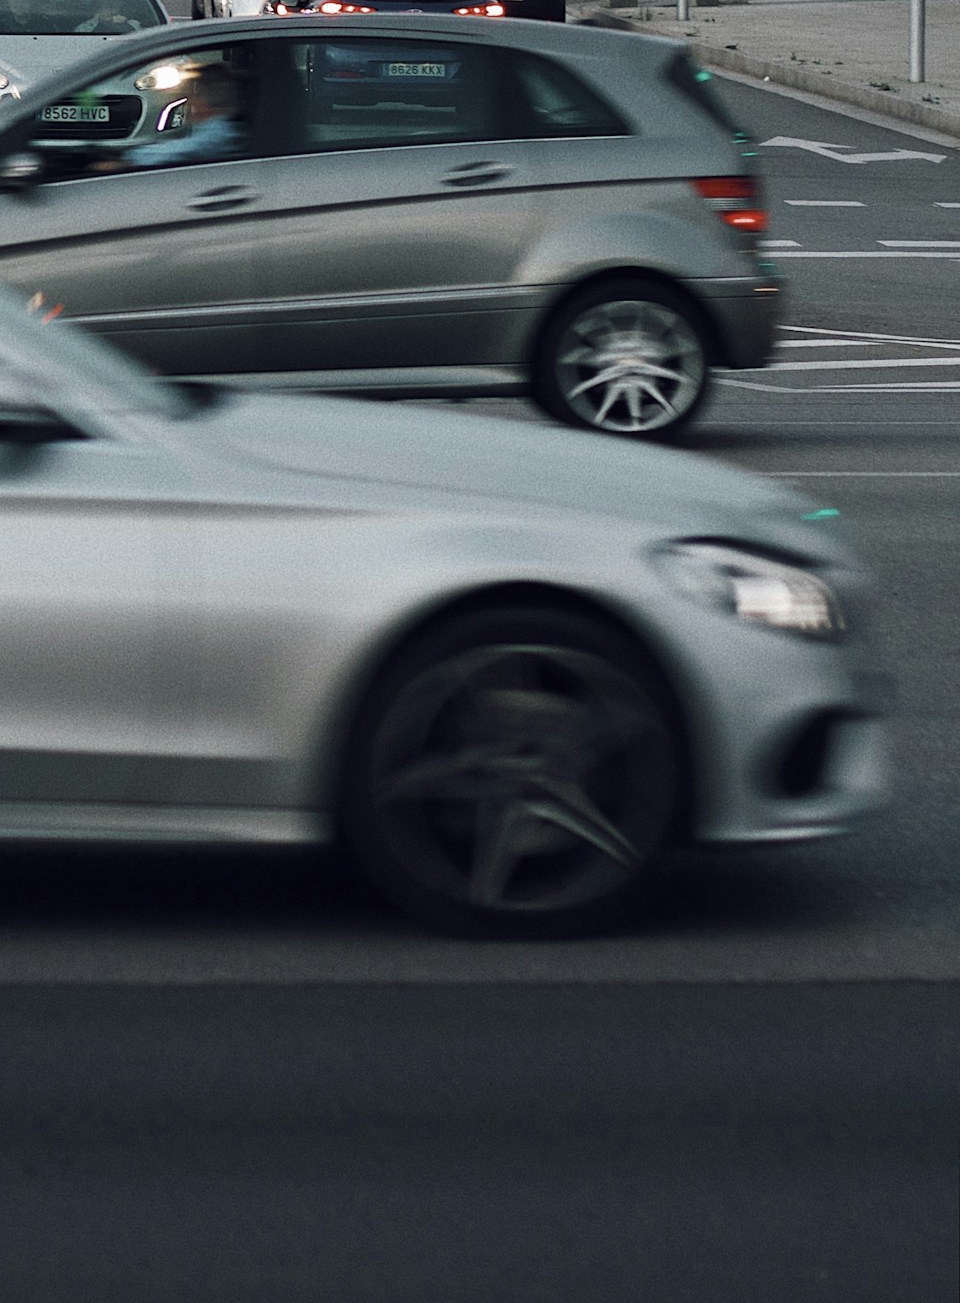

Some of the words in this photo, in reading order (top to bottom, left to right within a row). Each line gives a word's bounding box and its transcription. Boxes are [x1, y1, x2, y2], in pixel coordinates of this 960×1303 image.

[390, 64, 419, 75] 8626
[421, 64, 442, 75] KKX
[44, 107, 77, 120] 8562
[80, 107, 107, 120] HVC
